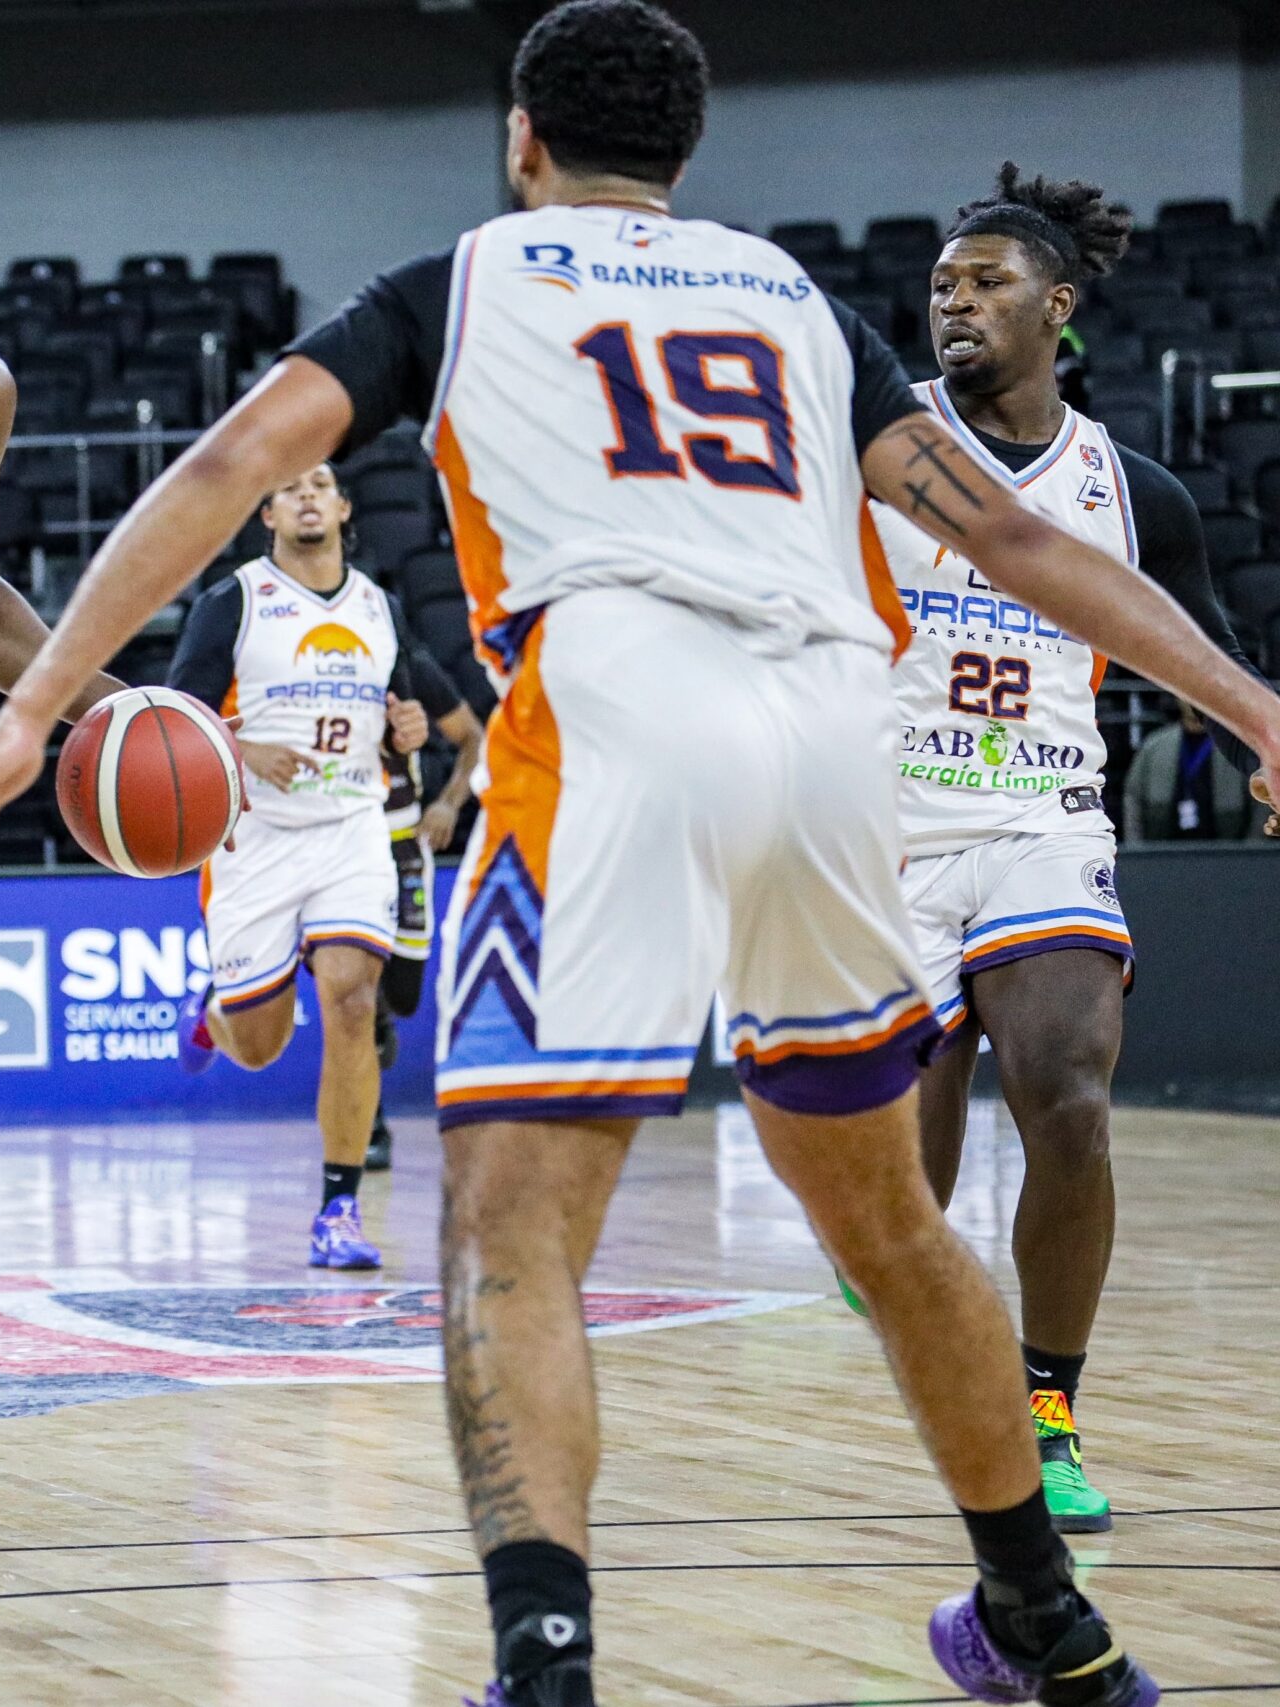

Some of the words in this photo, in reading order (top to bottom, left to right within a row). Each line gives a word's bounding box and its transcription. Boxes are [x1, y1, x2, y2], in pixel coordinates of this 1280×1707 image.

[590, 262, 812, 302] BANRESERVAS
[572, 319, 802, 502] 19
[897, 587, 1086, 645] PRADO
[315, 663, 357, 677] LOS
[948, 650, 1033, 722] 22
[311, 715, 352, 755] 12
[898, 760, 984, 788] nergía
[63, 1001, 179, 1032] SERVICIO
[65, 1031, 102, 1063] DE
